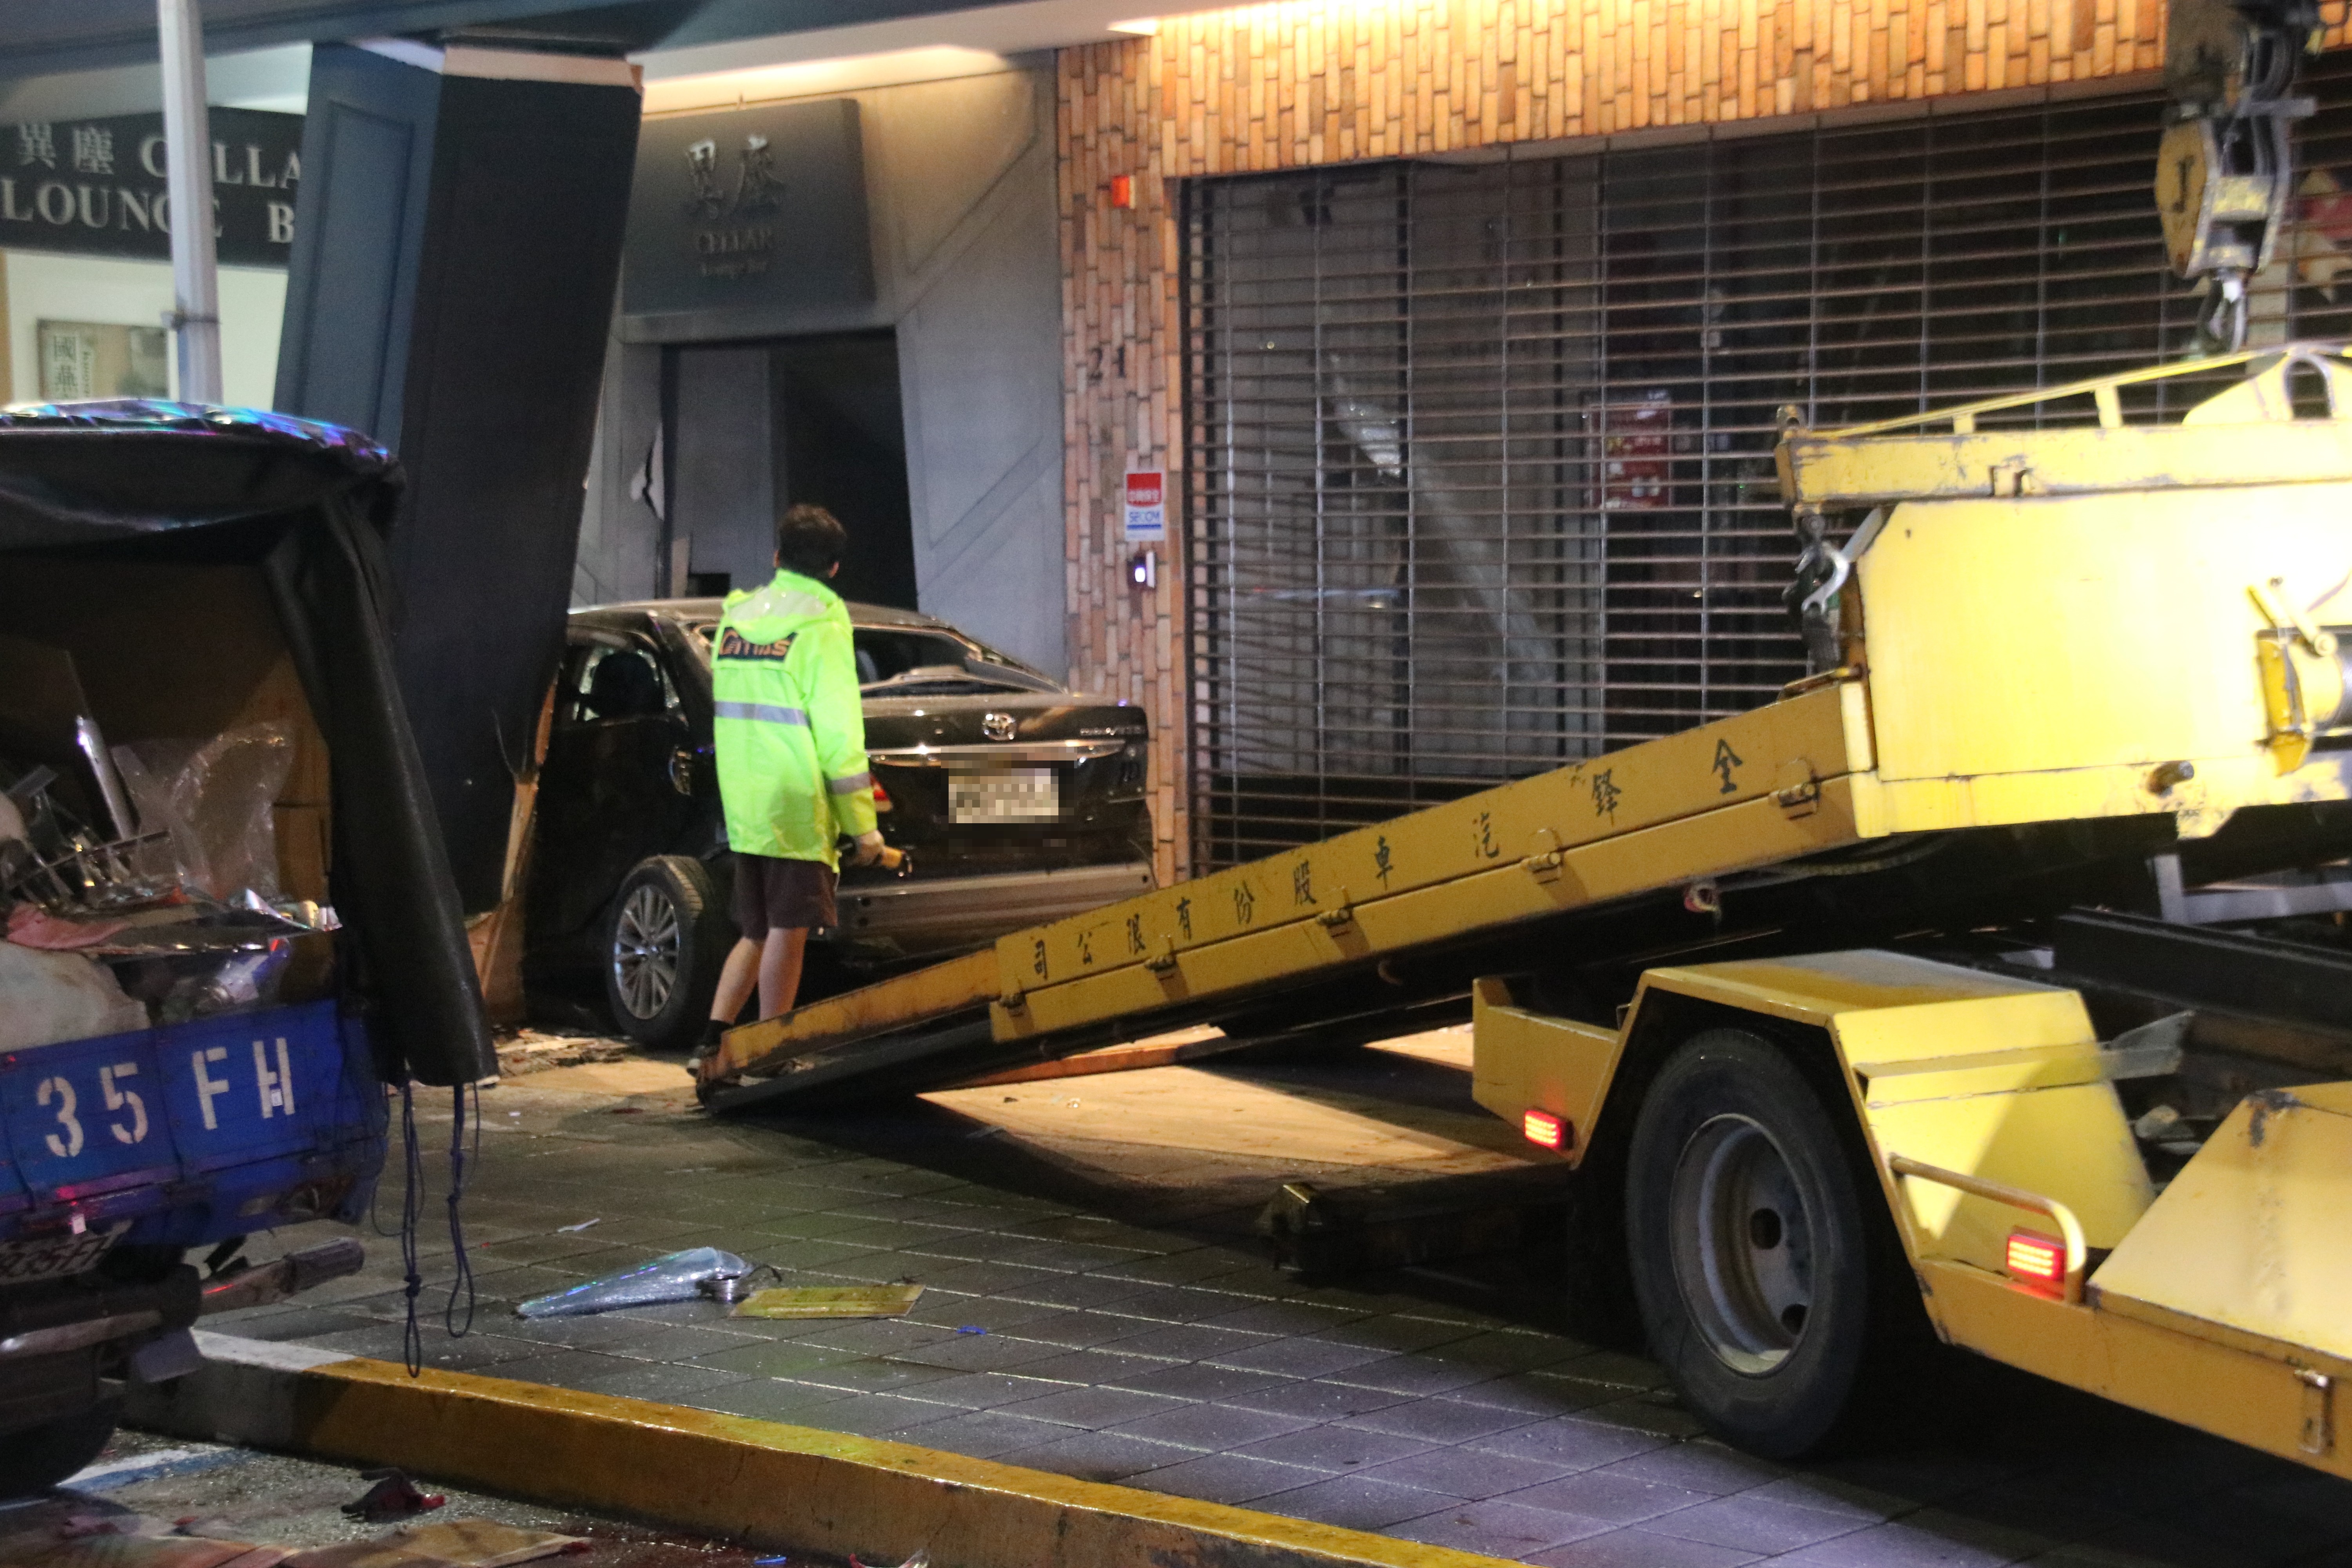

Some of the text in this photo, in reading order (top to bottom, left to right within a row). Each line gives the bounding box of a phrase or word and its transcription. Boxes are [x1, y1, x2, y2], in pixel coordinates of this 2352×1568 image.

[140, 135, 301, 189] CLLA
[36, 1037, 296, 1157] 35 FH
